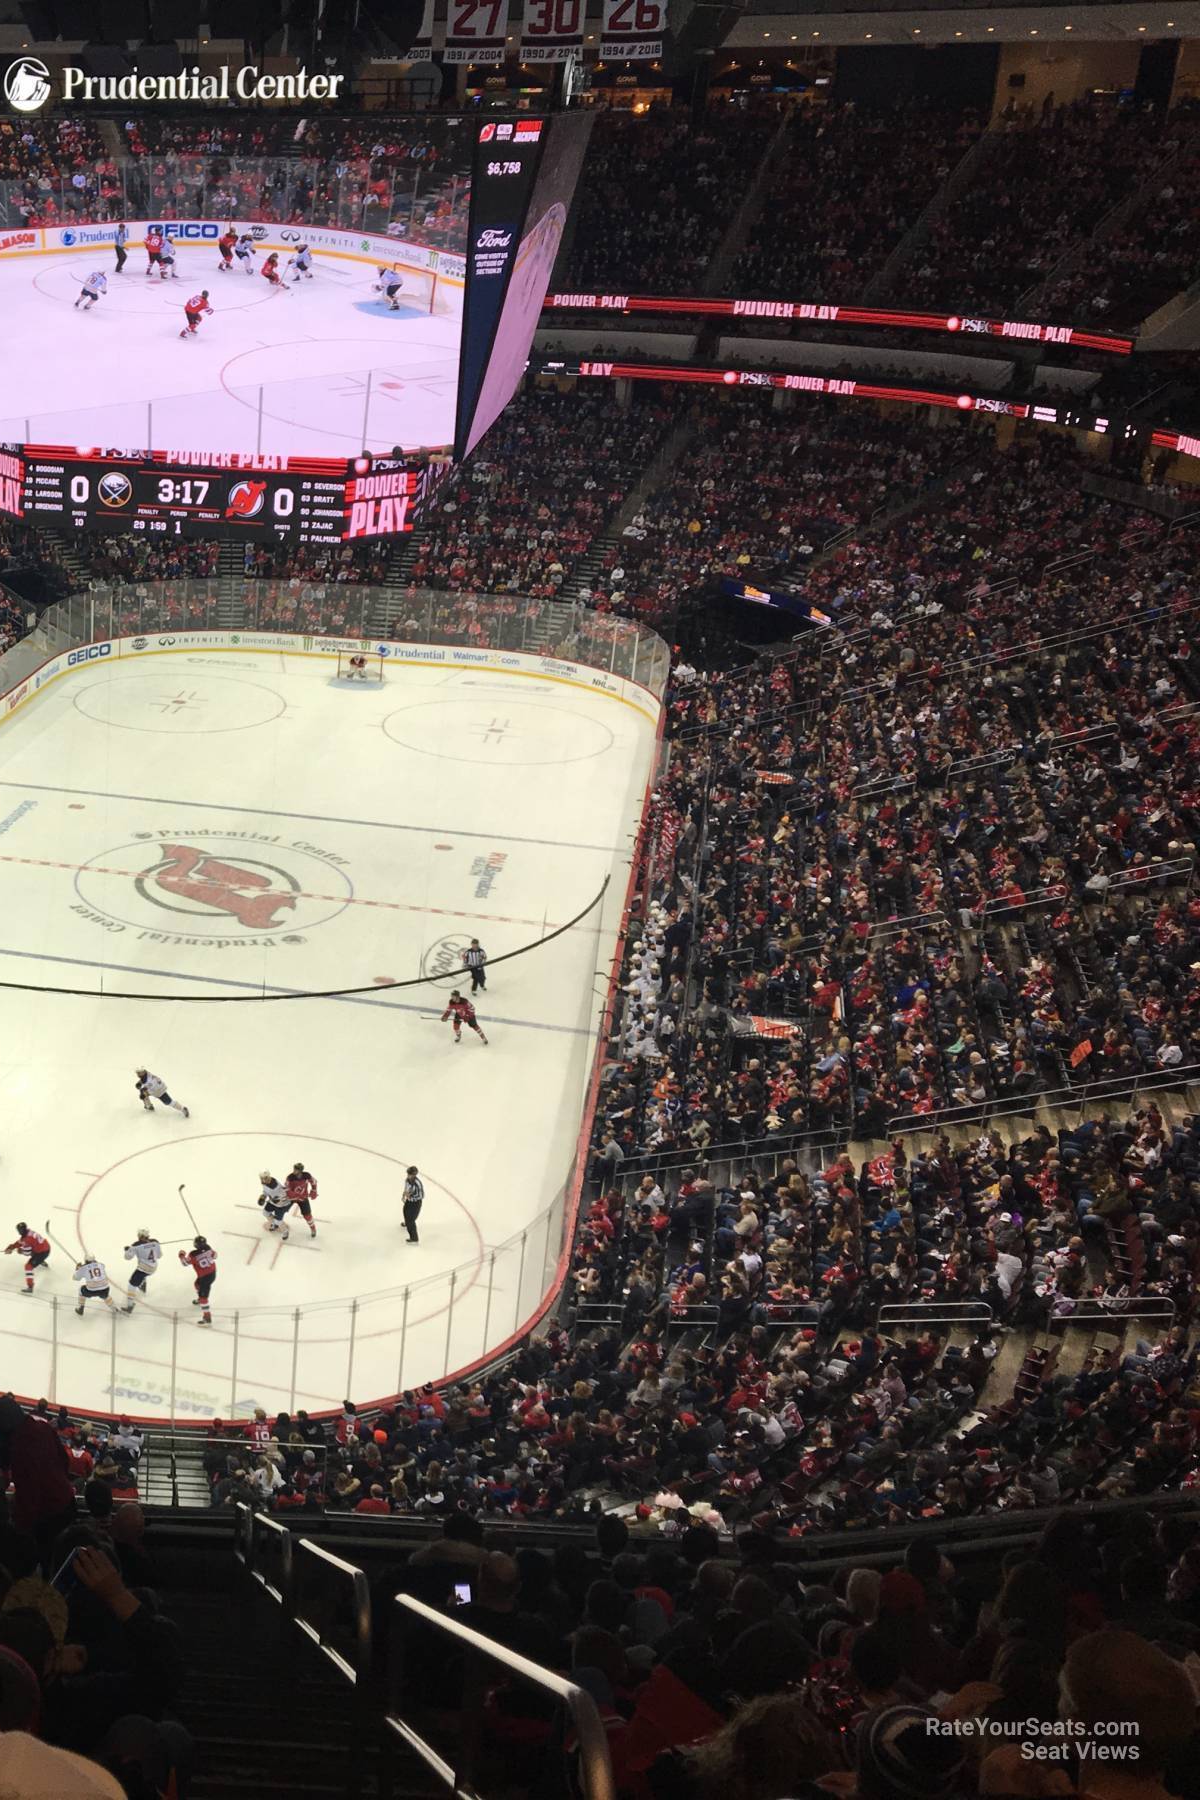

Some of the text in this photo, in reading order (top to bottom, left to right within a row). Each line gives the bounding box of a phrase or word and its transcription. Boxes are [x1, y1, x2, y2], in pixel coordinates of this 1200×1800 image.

[453, 0, 500, 36] 27
[527, 0, 579, 35] 30
[62, 65, 344, 99] Prudential Center
[487, 161, 521, 176] $6,758
[304, 234, 354, 247] INFINITI
[477, 229, 512, 248] Ford
[553, 294, 628, 308] POWER PLAY
[734, 300, 794, 318] POWER
[1002, 321, 1041, 339] POWER
[1045, 326, 1073, 343] PLAY
[785, 375, 824, 392] POWER
[828, 379, 856, 395] PLAY
[166, 451, 231, 467] POWER
[239, 454, 289, 471] PLAY
[71, 476, 89, 503] 0
[158, 478, 210, 505] 3:17
[355, 472, 408, 500] POWER
[274, 488, 294, 516] 0
[75, 518, 84, 526] 10
[312, 522, 333, 530] ZAJAC
[349, 496, 410, 538] PLAY
[175, 521, 181, 534] 1
[279, 532, 285, 540] 7
[311, 535, 341, 543] PALMIERI
[178, 636, 224, 645] INFINITI
[67, 643, 111, 666] GEICO
[394, 647, 445, 660] Prudential
[453, 650, 488, 663] Walmart
[158, 828, 351, 867] Prudential Center
[69, 903, 276, 949] Center Prudential
